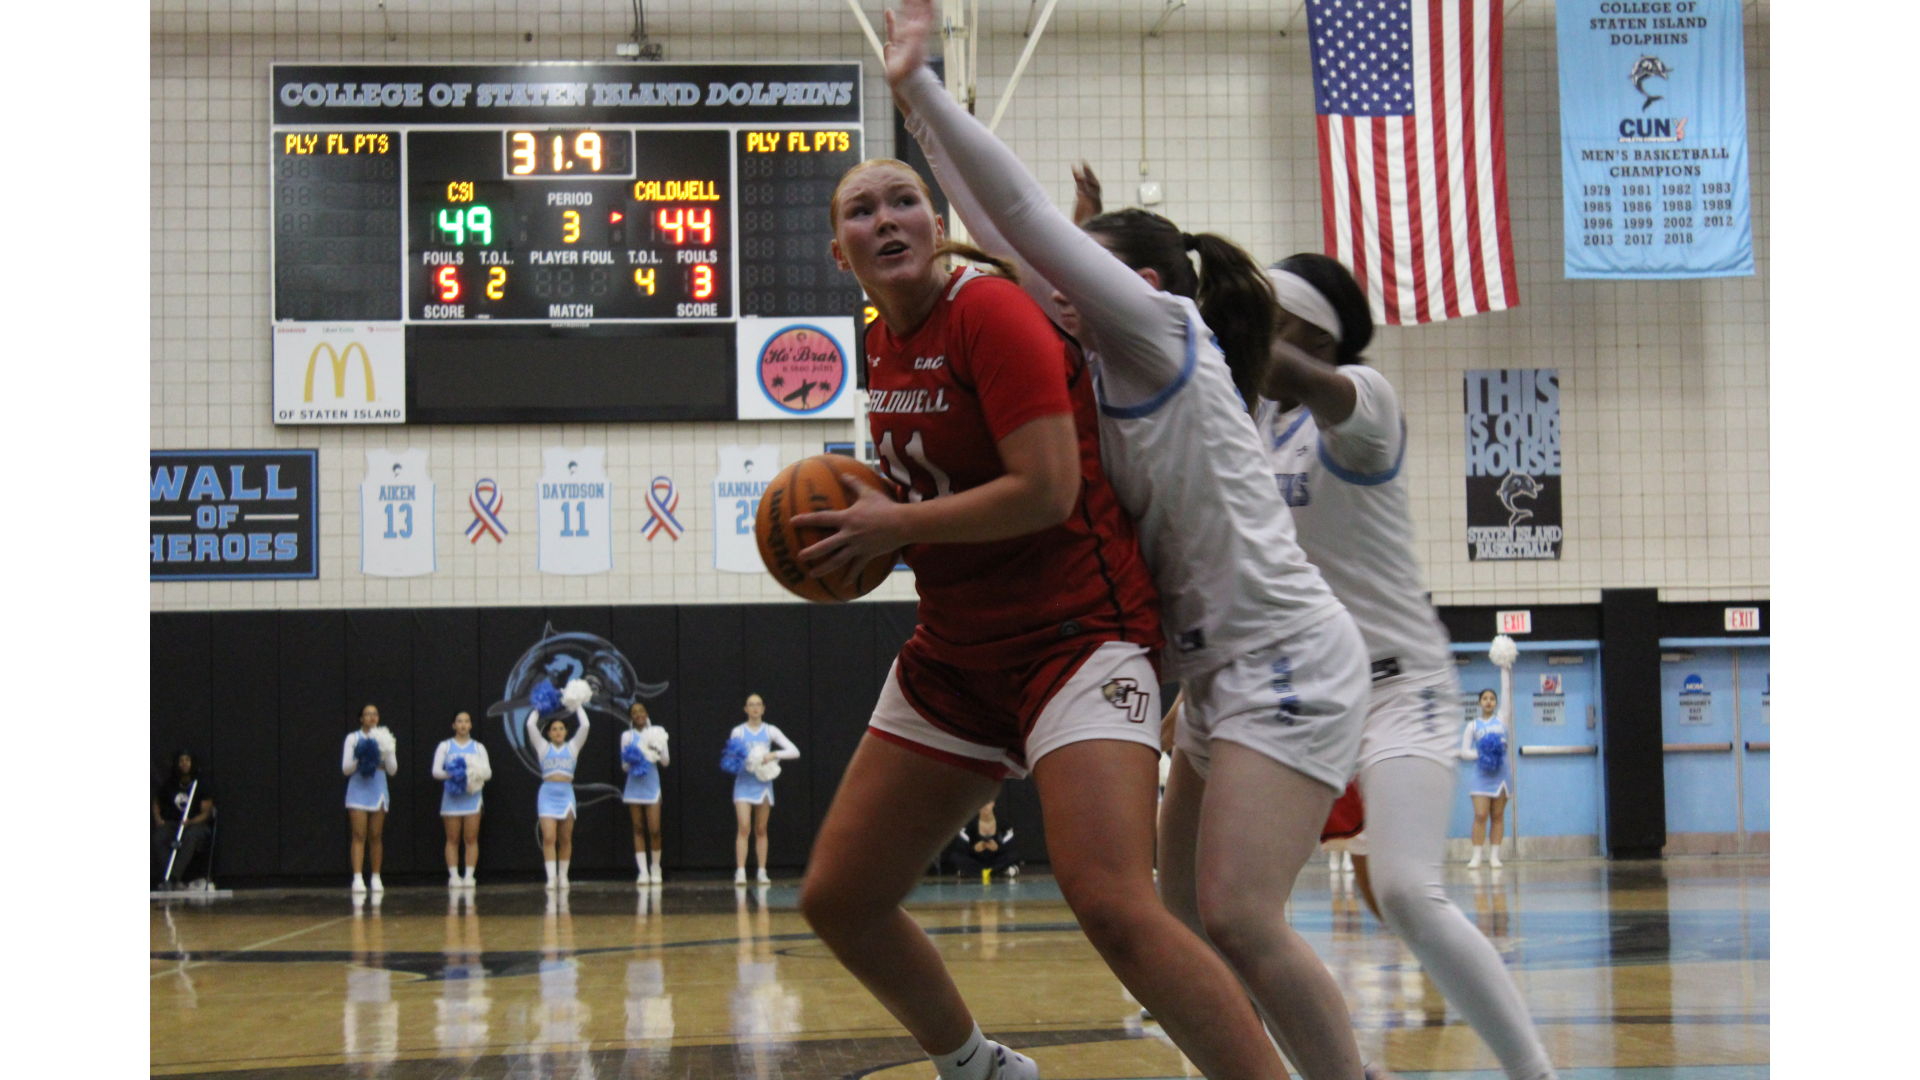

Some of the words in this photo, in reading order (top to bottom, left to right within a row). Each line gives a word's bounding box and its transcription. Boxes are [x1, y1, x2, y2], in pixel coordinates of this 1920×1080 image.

[1600, 2, 1672, 13] COLLEGE
[1676, 2, 1697, 13] OF
[1590, 18, 1647, 30] STATEN
[1653, 17, 1707, 28] ISLAND
[1611, 33, 1689, 45] DOLPHINS
[280, 83, 423, 107] COLLEGE
[429, 83, 472, 107] OF
[476, 82, 588, 107] STATEN
[593, 82, 700, 106] ISLAND
[705, 82, 853, 106] DOLPHINS
[286, 134, 318, 154] PLY
[327, 134, 349, 154] FL
[354, 134, 389, 154] PTS
[747, 132, 780, 152] PLY
[788, 132, 810, 152] FL
[814, 131, 850, 152] PTS
[513, 132, 601, 174] 31.9
[1582, 149, 1628, 161] MEN'S
[1634, 148, 1729, 160] BASKETBALL
[1610, 165, 1701, 178] CHAMPIONS
[447, 181, 474, 202] CSI
[634, 180, 720, 201] CALDWELL
[1583, 185, 1610, 196] 1979
[1622, 185, 1651, 196] 1981
[1662, 184, 1691, 195] 1982
[1702, 183, 1731, 194] 1983
[548, 192, 593, 206] PERIOD
[1583, 202, 1612, 212] 1985
[1623, 202, 1652, 212] 1986
[1663, 200, 1692, 211] 1988
[1703, 199, 1732, 210] 1989
[439, 206, 492, 245] 49
[563, 210, 580, 243] 3
[659, 208, 713, 244] 44
[1584, 218, 1613, 229] 1996
[1624, 218, 1653, 229] 1999
[1664, 217, 1693, 228] 2002
[1704, 216, 1733, 227] 2012
[1584, 235, 1613, 246] 2013
[1625, 234, 1653, 245] 2017
[1665, 233, 1693, 245] 2018
[423, 251, 464, 265] FOULS
[479, 251, 514, 265] T.O.L.
[530, 251, 578, 265] PLAYER
[582, 251, 615, 264] FOUL
[628, 250, 662, 264] T.O.L.
[677, 250, 718, 264] FOULS
[439, 266, 461, 302] 5
[487, 267, 506, 299] 2
[634, 268, 655, 295] 4
[693, 264, 713, 299] 3
[424, 305, 465, 318] SCORE
[550, 304, 594, 318] MATCH
[677, 303, 718, 317] SCORE
[793, 346, 837, 362] Brah
[869, 388, 950, 413] ALDWELL
[1464, 369, 1560, 415] THIS
[279, 410, 295, 420] OF
[300, 409, 348, 420] STATEN
[354, 408, 401, 419] ISLAND
[1465, 413, 1489, 445] IS
[1495, 412, 1561, 444] OUR
[1465, 443, 1562, 477] HOUSE
[150, 464, 297, 500] WALL
[542, 483, 605, 499] DAVIDSON
[379, 485, 416, 501] AIKEN
[197, 504, 239, 529] OF
[383, 503, 413, 539] 13
[560, 501, 589, 537] 11
[1467, 526, 1514, 543] STATEN
[1516, 525, 1562, 542] ISLAND
[1476, 541, 1555, 558] BASKETBALL
[1503, 612, 1526, 631] EXIT
[1731, 610, 1754, 628] EXIT
